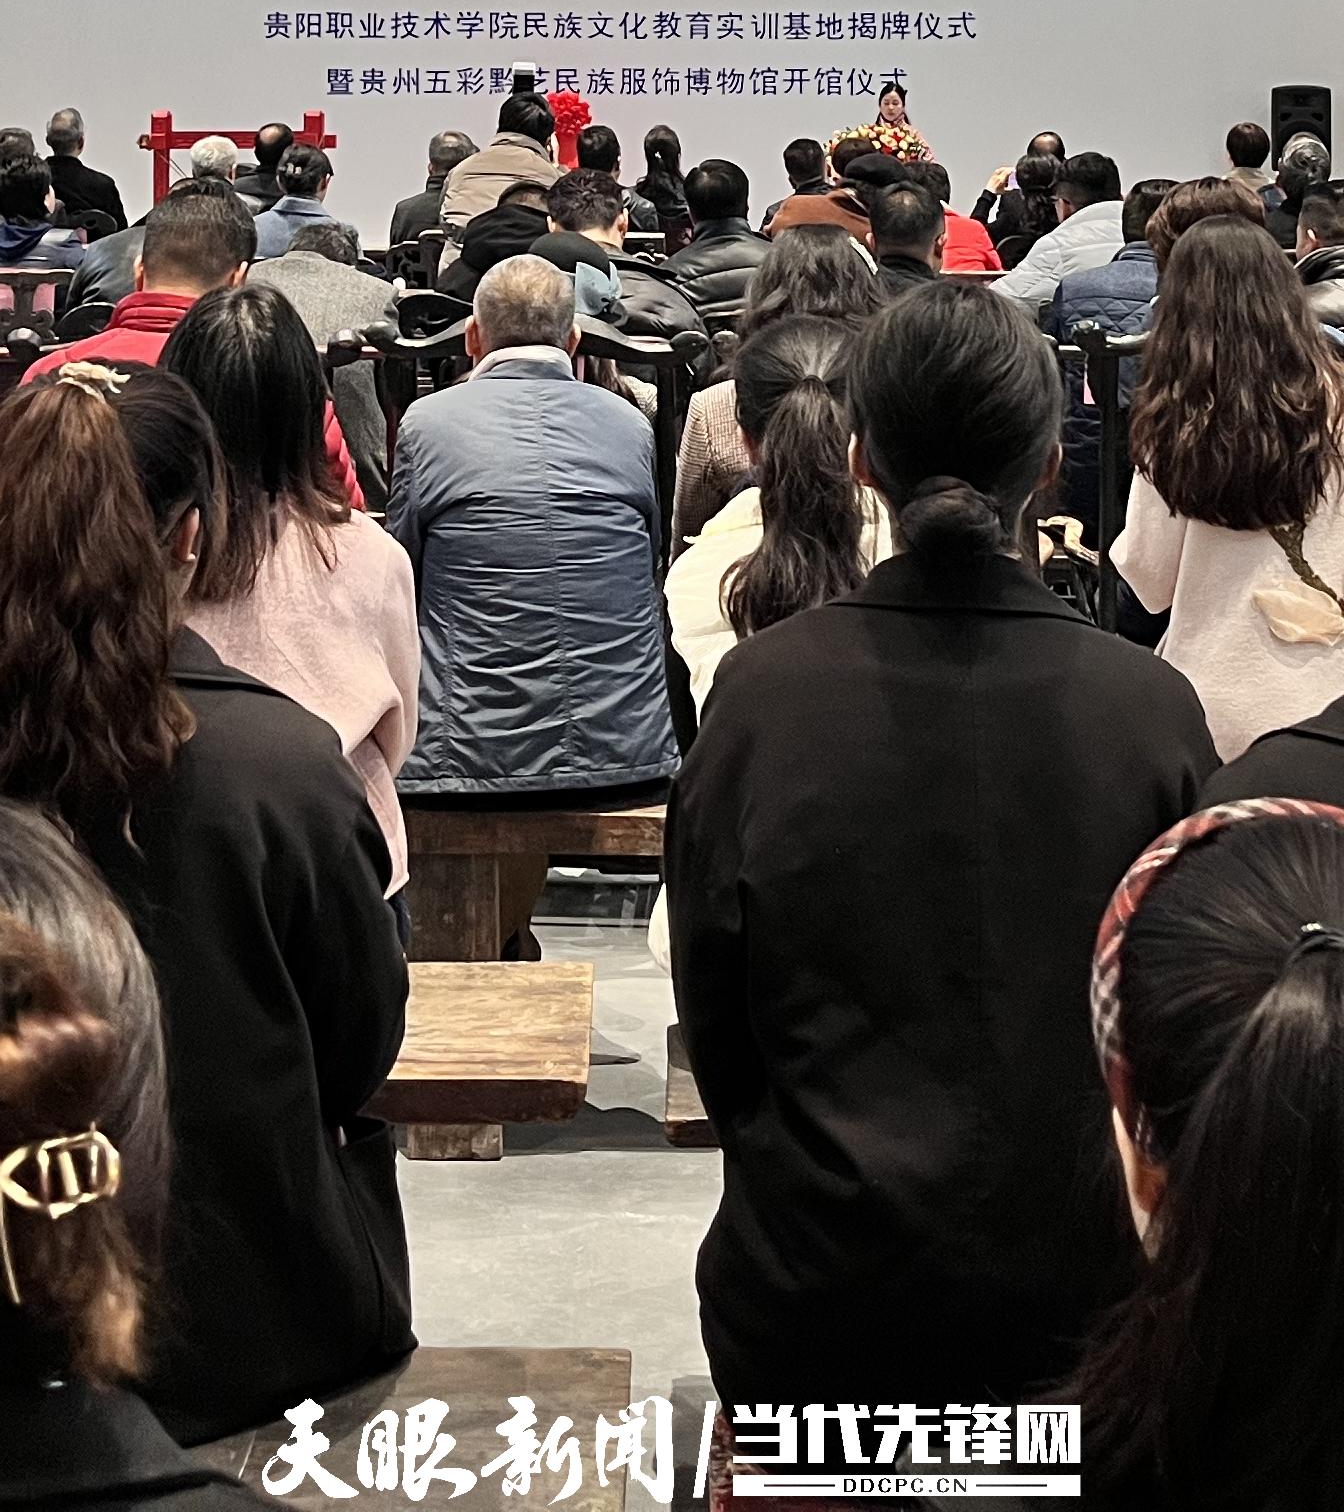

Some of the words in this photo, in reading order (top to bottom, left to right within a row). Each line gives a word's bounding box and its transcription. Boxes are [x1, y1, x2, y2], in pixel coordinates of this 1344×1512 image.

[264, 11, 977, 40] 贵阳职业技术学院民族文化教育实训基地揭牌仪式
